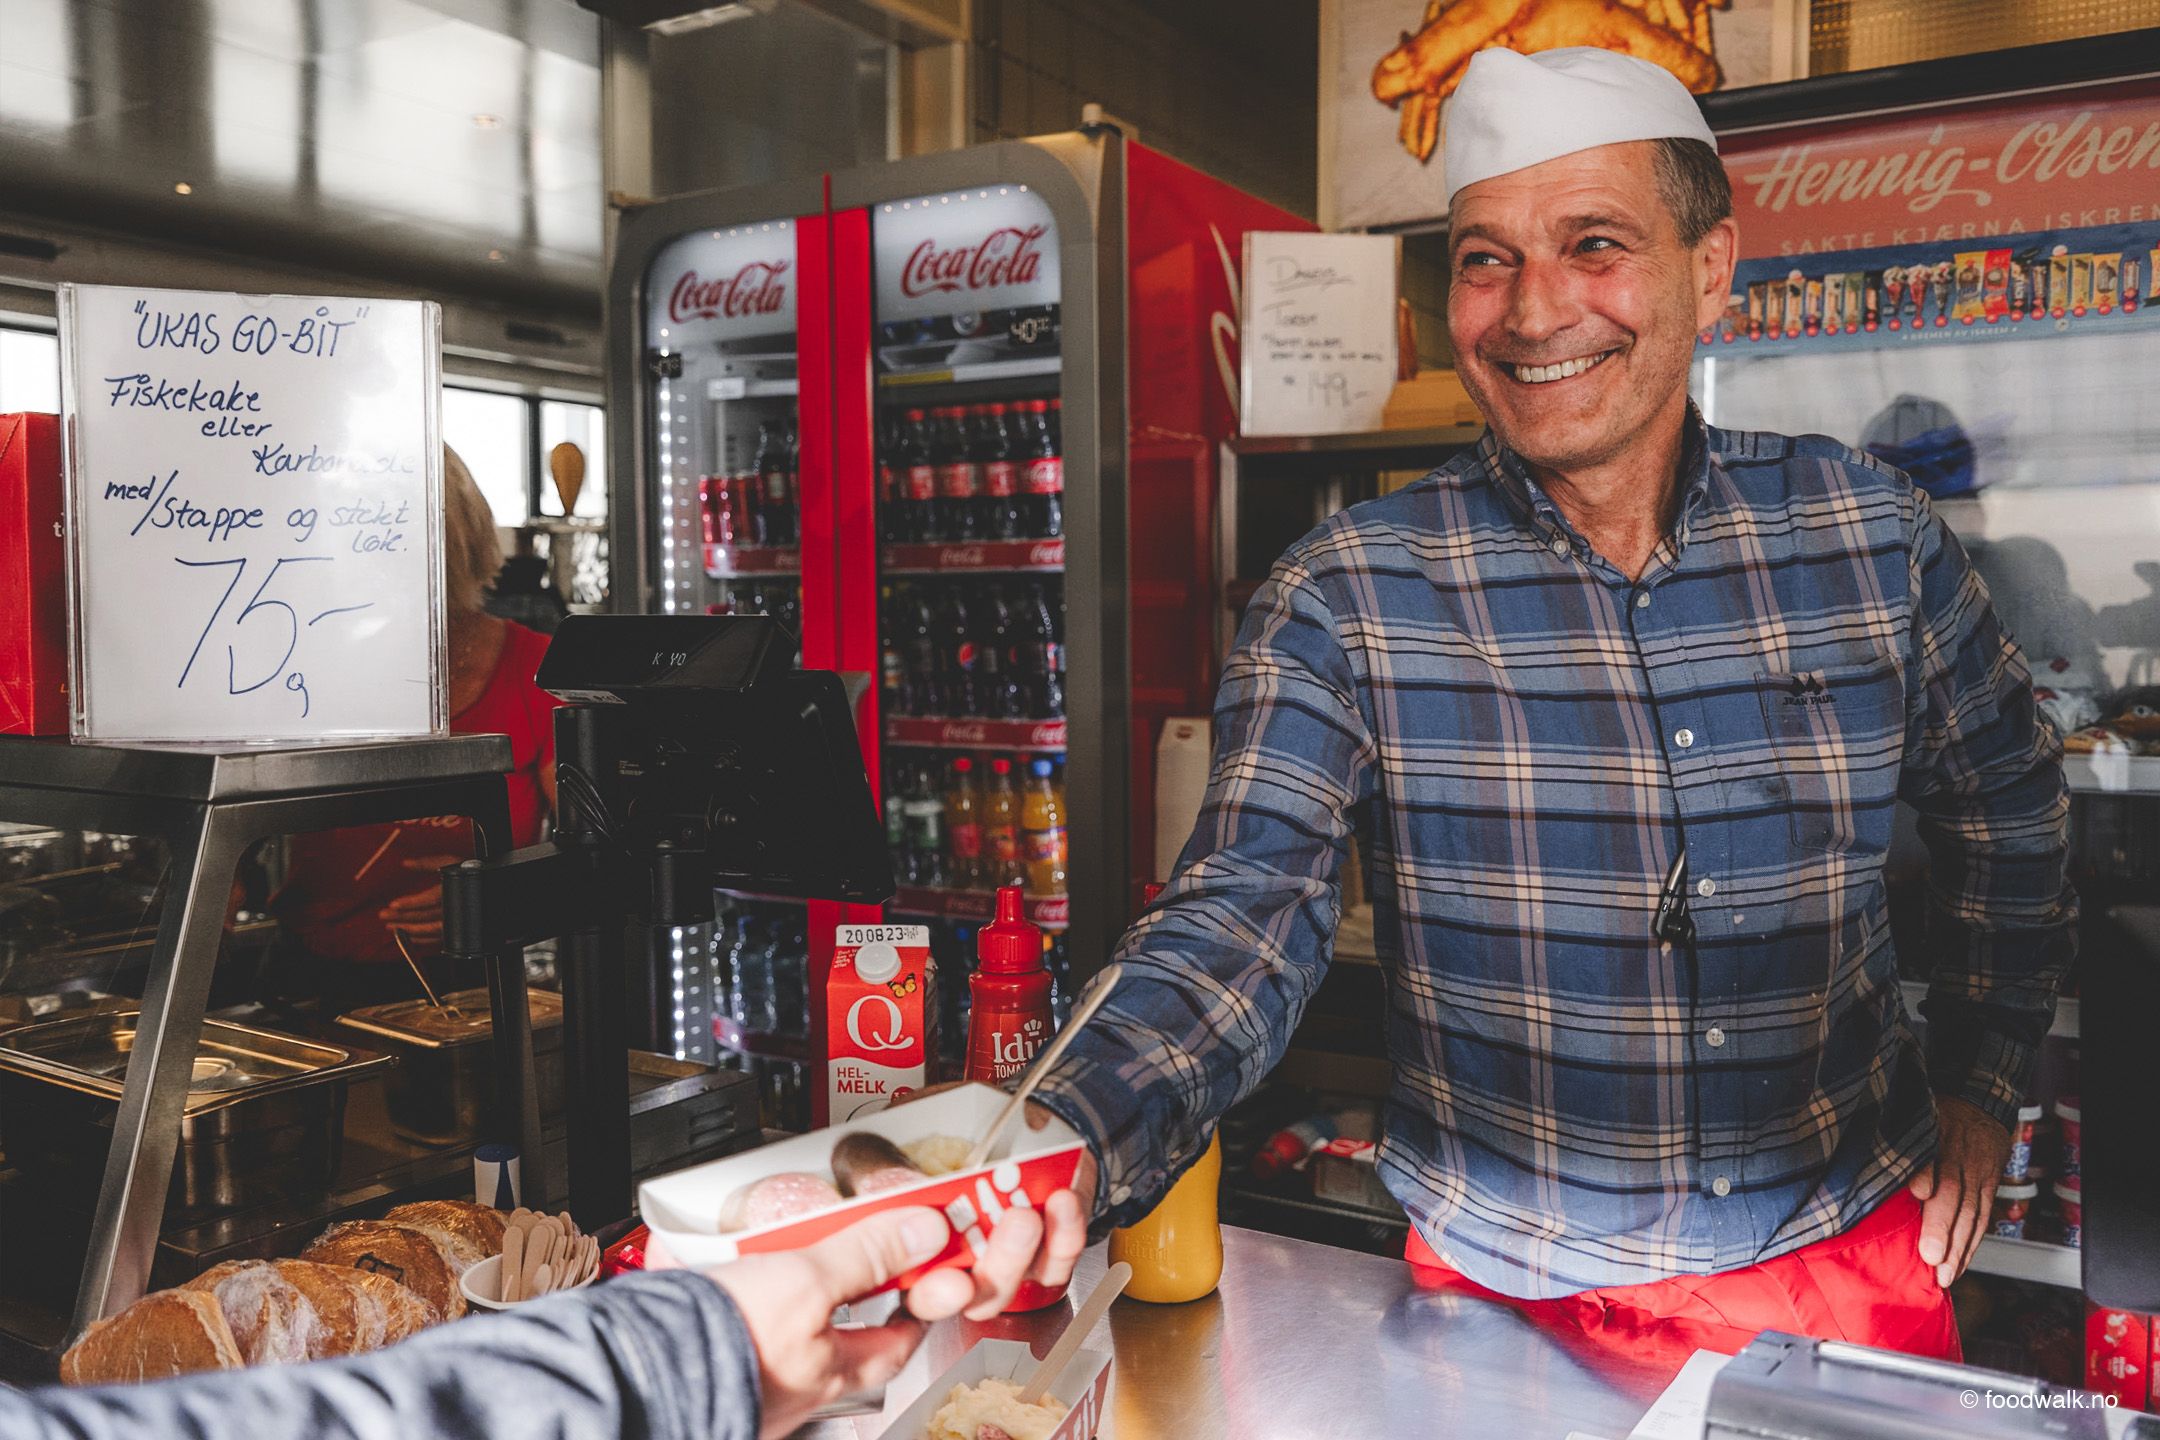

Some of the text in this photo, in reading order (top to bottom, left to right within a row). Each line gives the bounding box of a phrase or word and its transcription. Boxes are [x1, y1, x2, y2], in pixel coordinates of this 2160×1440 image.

[1780, 231, 1877, 256] SAKTE
[1893, 213, 2027, 244] KJÆRNA
[901, 223, 1049, 299] Coca-Cola
[669, 260, 791, 324] Coca-Cola
[105, 374, 262, 412] Fiskekake
[201, 416, 273, 437] eller
[252, 443, 415, 476] Karbode
[287, 508, 318, 542] og
[847, 995, 915, 1051] Q
[992, 1032, 1048, 1063] Idu
[837, 1067, 870, 1078] HEL-
[837, 1080, 886, 1094] MELK
